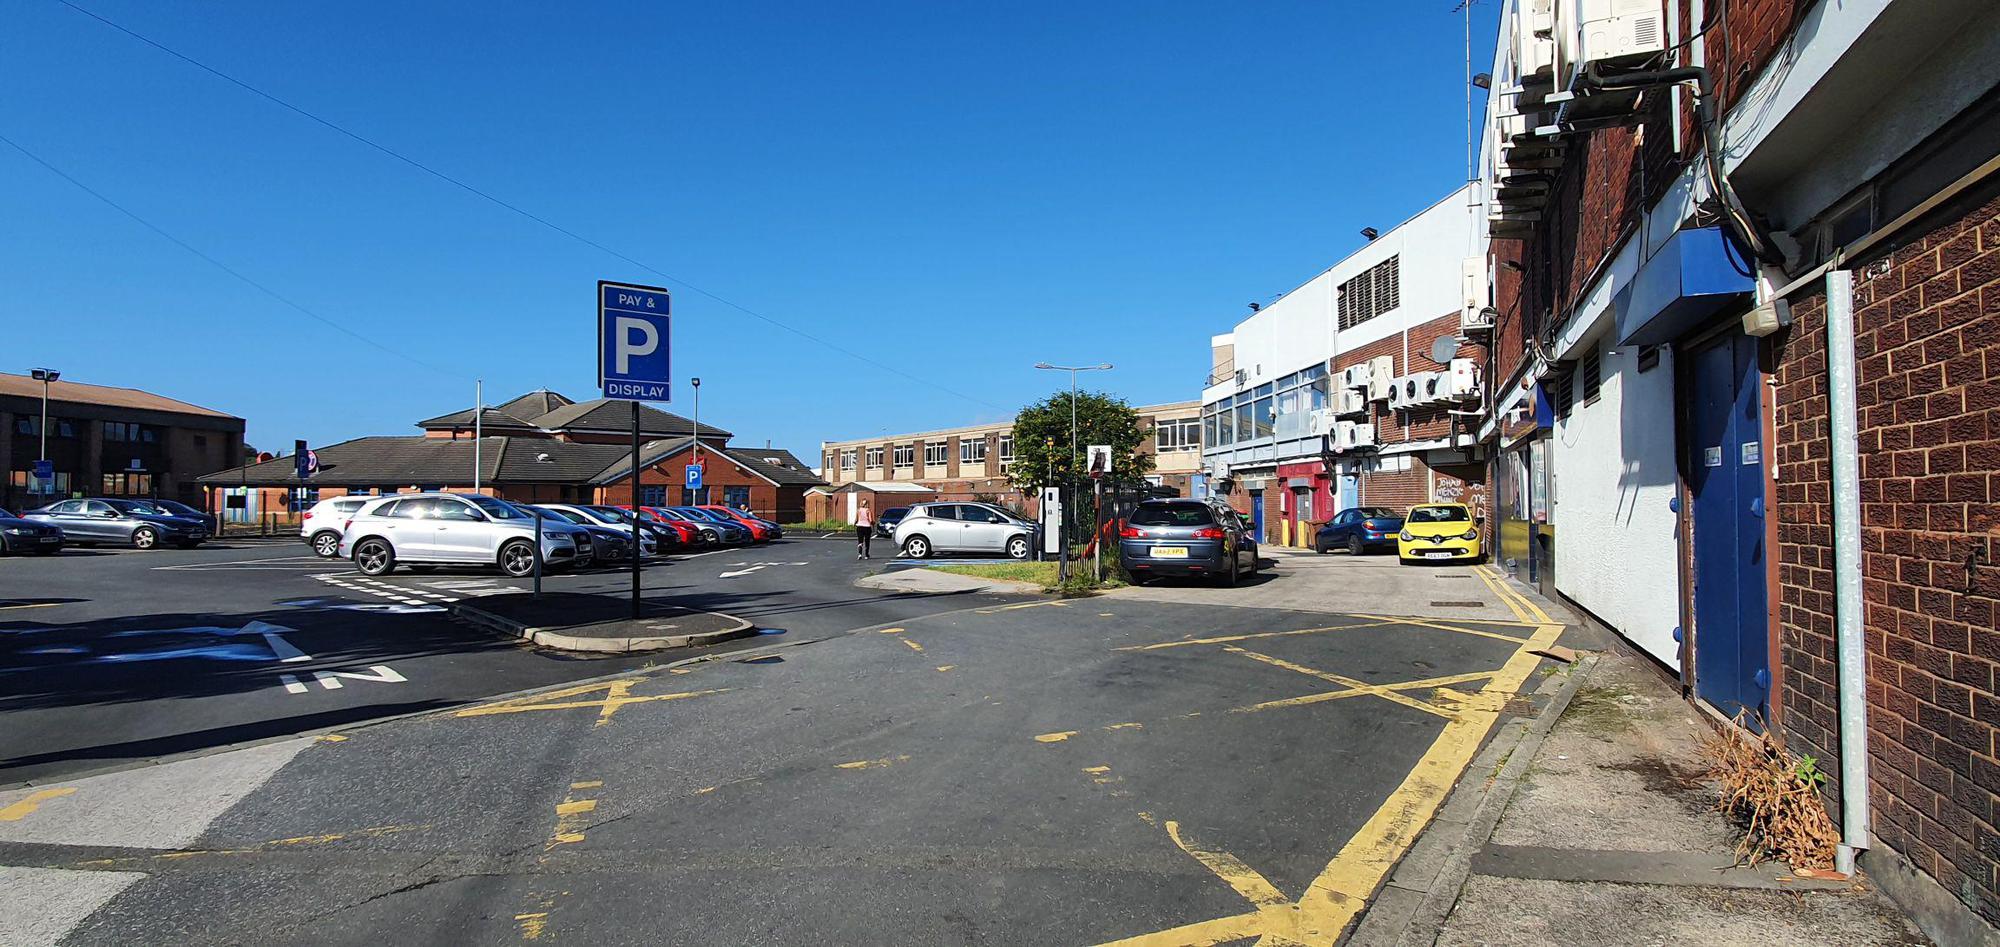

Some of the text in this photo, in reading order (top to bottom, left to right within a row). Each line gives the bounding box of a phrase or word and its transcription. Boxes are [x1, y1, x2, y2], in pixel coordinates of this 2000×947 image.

[619, 293, 655, 308] PAY &
[615, 316, 659, 374] P
[608, 383, 664, 397] DISPLAY
[689, 471, 698, 483] P
